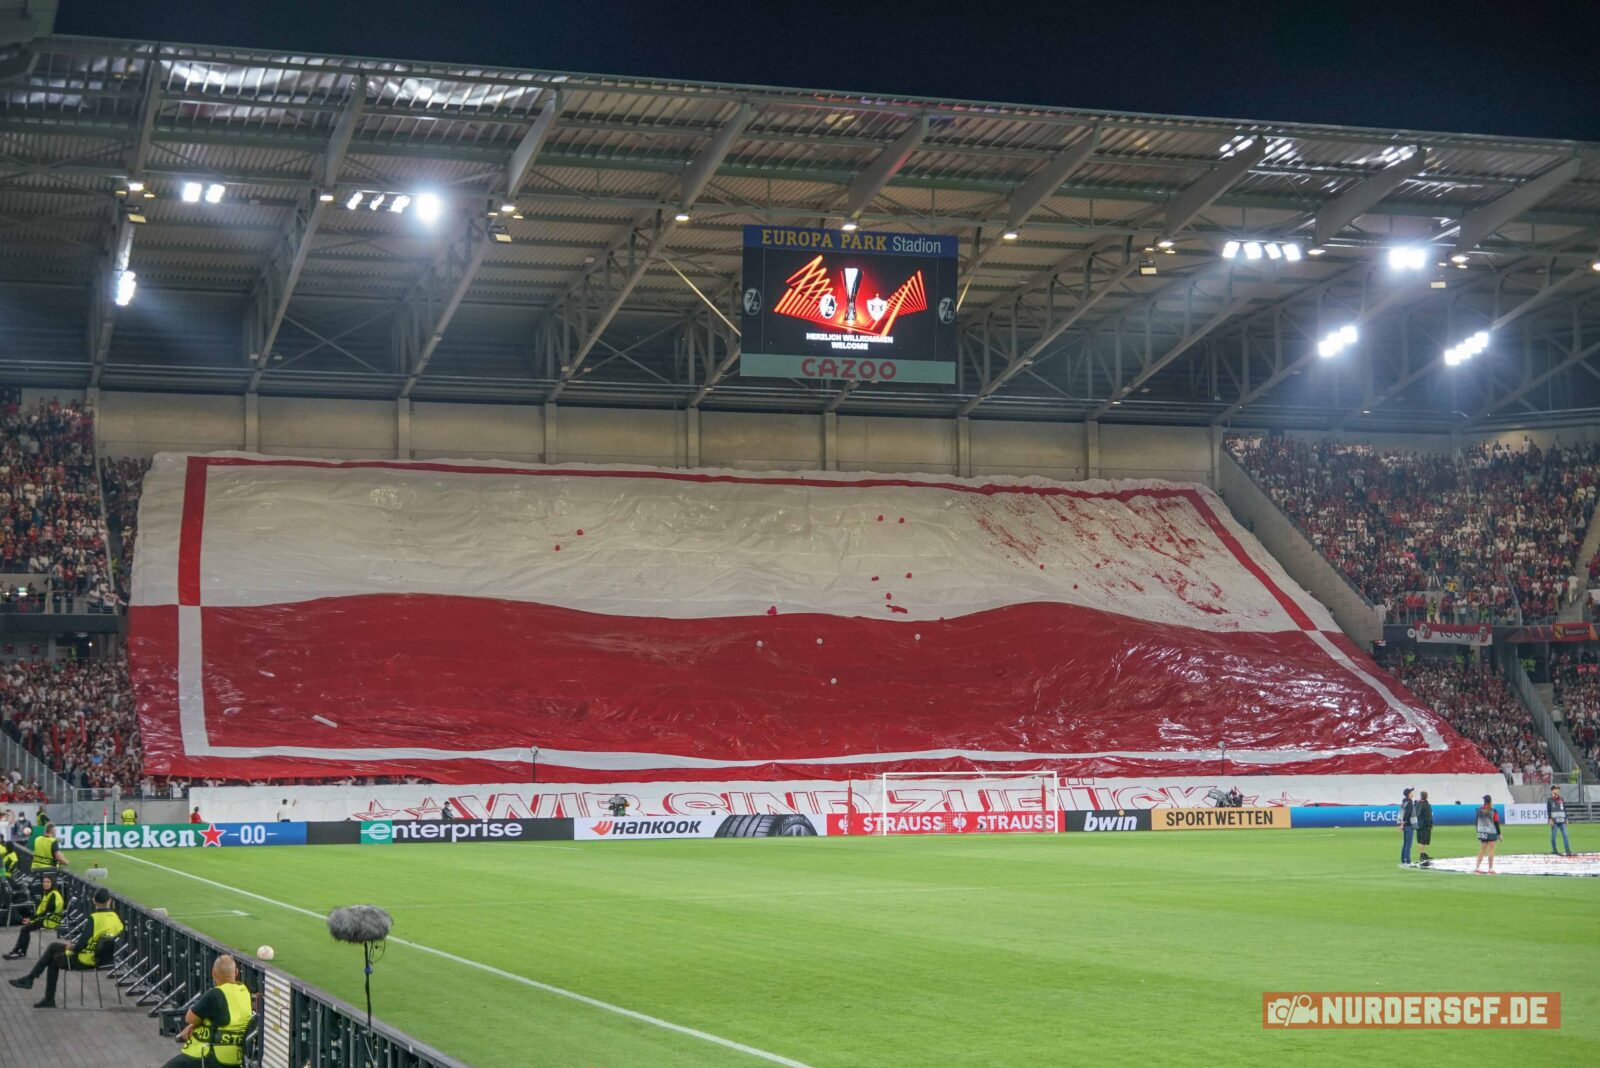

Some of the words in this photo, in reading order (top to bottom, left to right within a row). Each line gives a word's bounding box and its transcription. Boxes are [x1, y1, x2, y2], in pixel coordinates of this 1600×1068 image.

[761, 229, 833, 248] EUROPA
[840, 233, 887, 251] PARK
[892, 236, 941, 253] Stadion
[806, 333, 842, 341] HERZLICH
[843, 334, 894, 344] WILLKOMMEN
[831, 342, 868, 350] WELCOME
[801, 358, 896, 379] CAZOO
[977, 814, 1055, 831] STRAUSS
[1084, 809, 1138, 831] bwin
[1166, 810, 1273, 826] SPORTWETTEN
[1364, 811, 1397, 822] PEACE
[1520, 809, 1550, 820] RESPE
[361, 818, 523, 843] enterprise
[863, 815, 943, 832] STRAUSS
[55, 825, 197, 849] Heineken
[240, 825, 266, 844] 0.0
